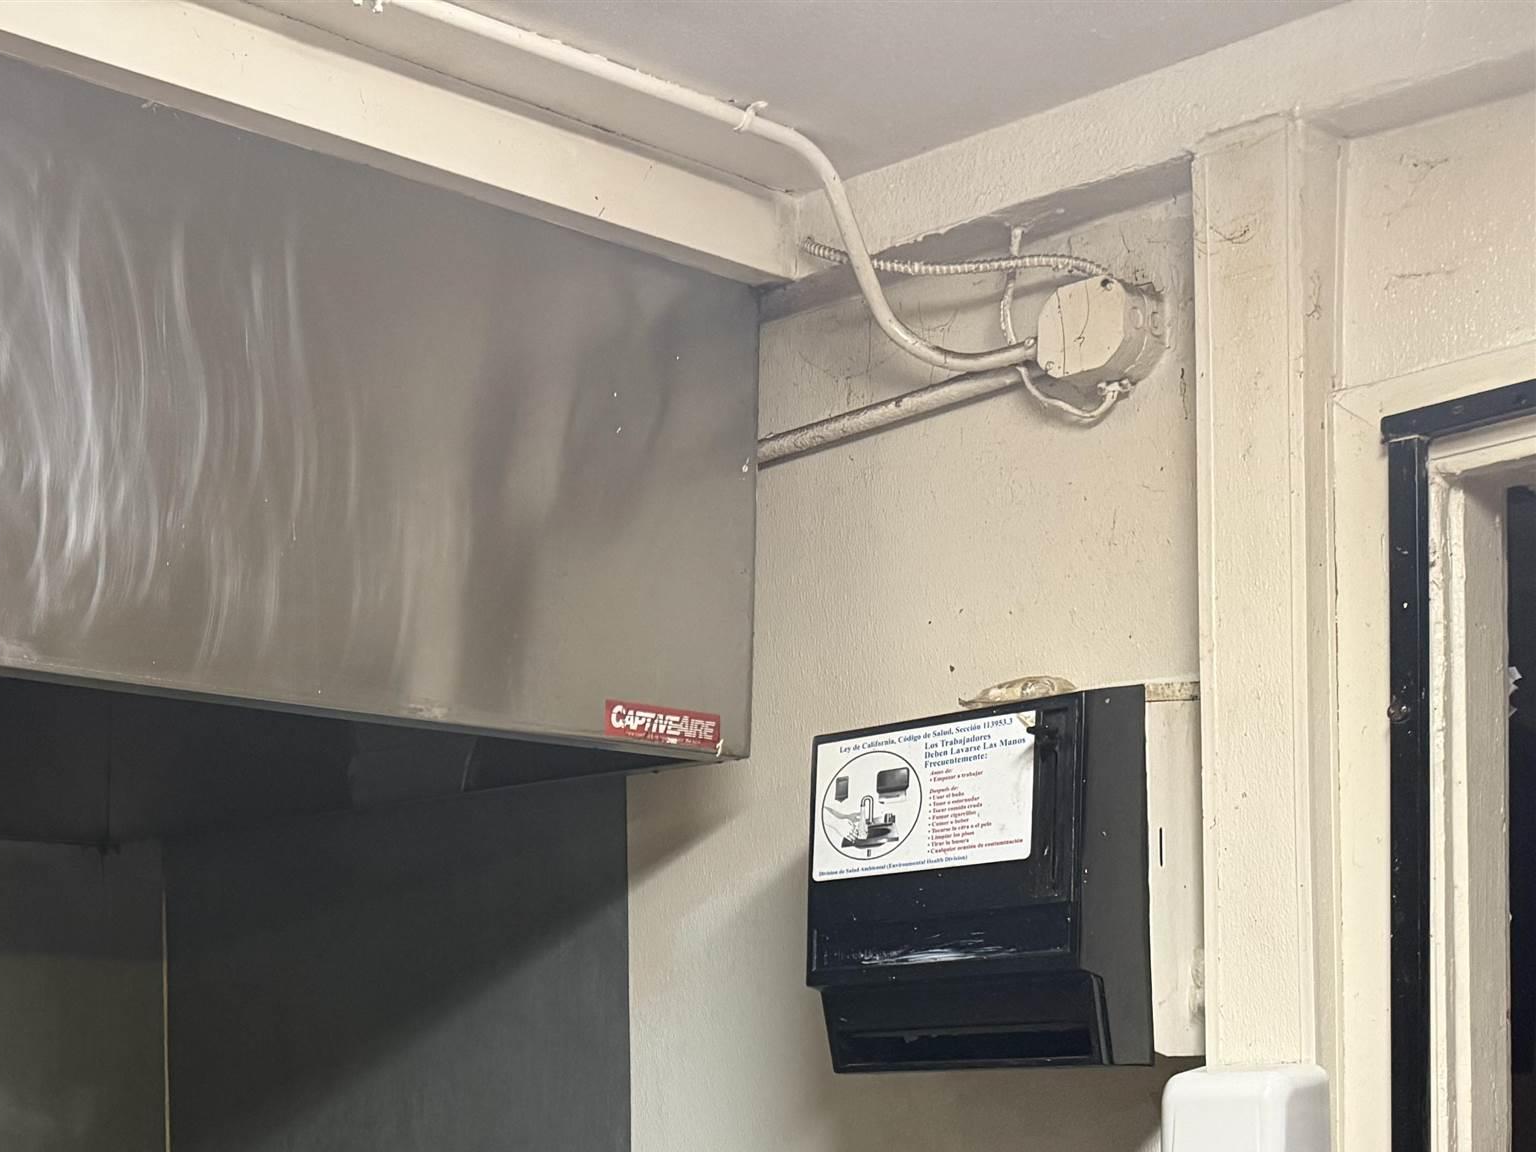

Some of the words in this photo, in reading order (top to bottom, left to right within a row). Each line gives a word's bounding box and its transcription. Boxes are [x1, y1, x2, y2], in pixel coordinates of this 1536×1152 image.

[839, 746, 852, 754] Ley
[852, 744, 861, 752] de
[861, 738, 897, 750] California,
[897, 734, 922, 744] Código
[922, 732, 931, 740] de
[932, 728, 954, 738] Salud,
[955, 723, 982, 734] Sección
[924, 742, 939, 751] Los
[941, 733, 991, 748] Trabajadores
[924, 749, 948, 760] Deben
[950, 744, 981, 756] Lavarse
[983, 741, 998, 751] Las
[999, 736, 1027, 748] Manos
[924, 753, 988, 769] Frecuentemente:
